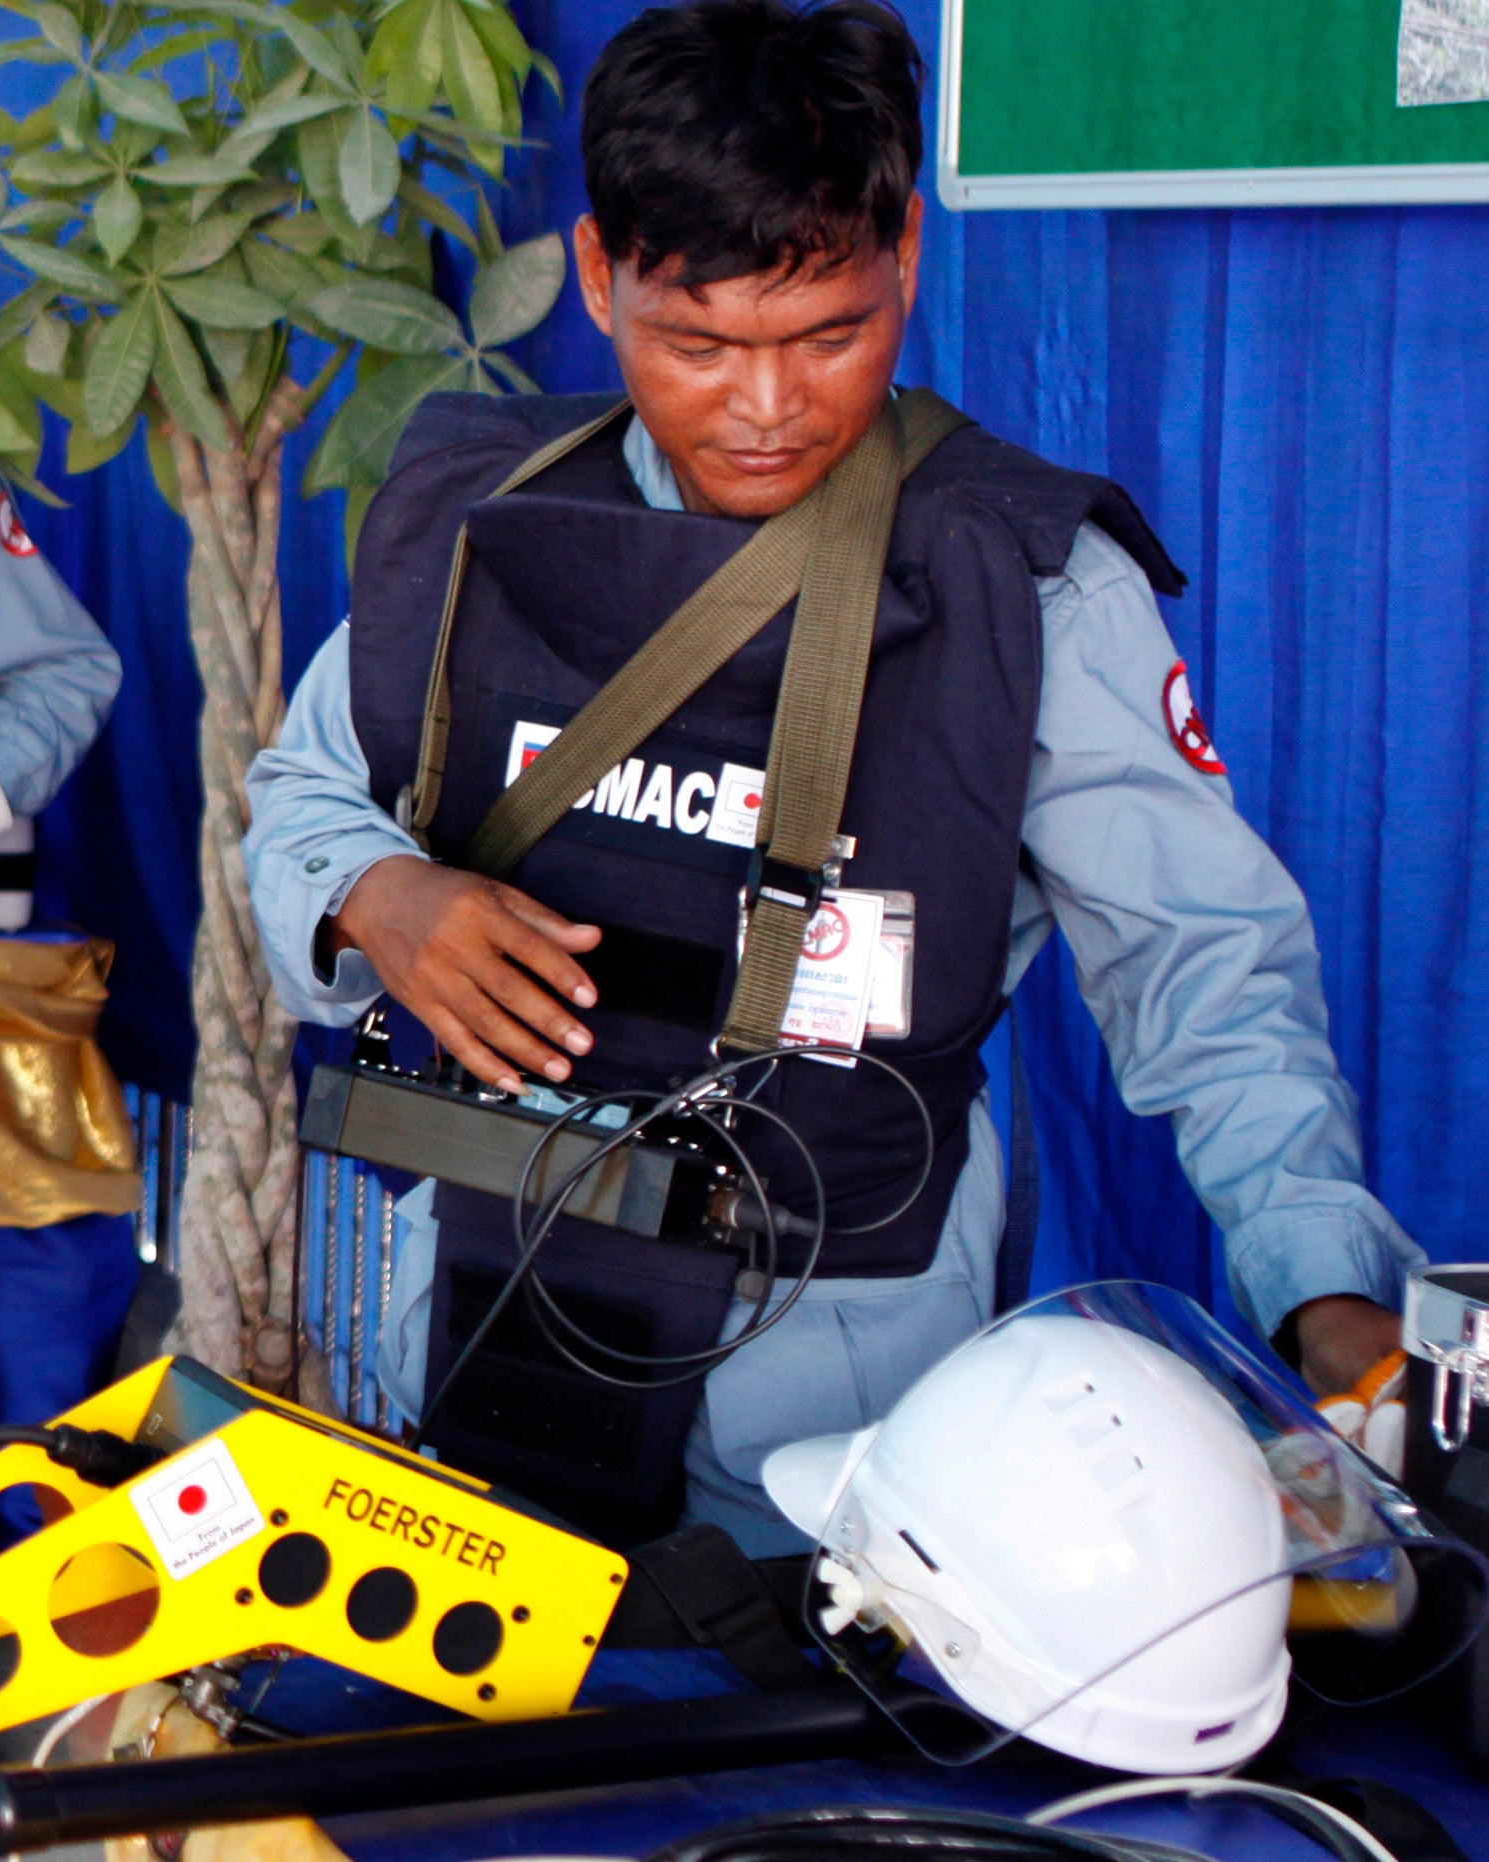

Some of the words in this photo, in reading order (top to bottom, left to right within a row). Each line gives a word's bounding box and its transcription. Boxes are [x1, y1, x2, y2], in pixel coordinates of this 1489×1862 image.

[572, 758, 716, 835] MAC
[173, 1558, 188, 1570] the
[188, 1540, 218, 1560] People
[219, 1531, 229, 1543] of
[230, 1517, 256, 1536] Japan
[198, 1525, 221, 1542] From
[323, 1478, 507, 1577] FOERSTER
